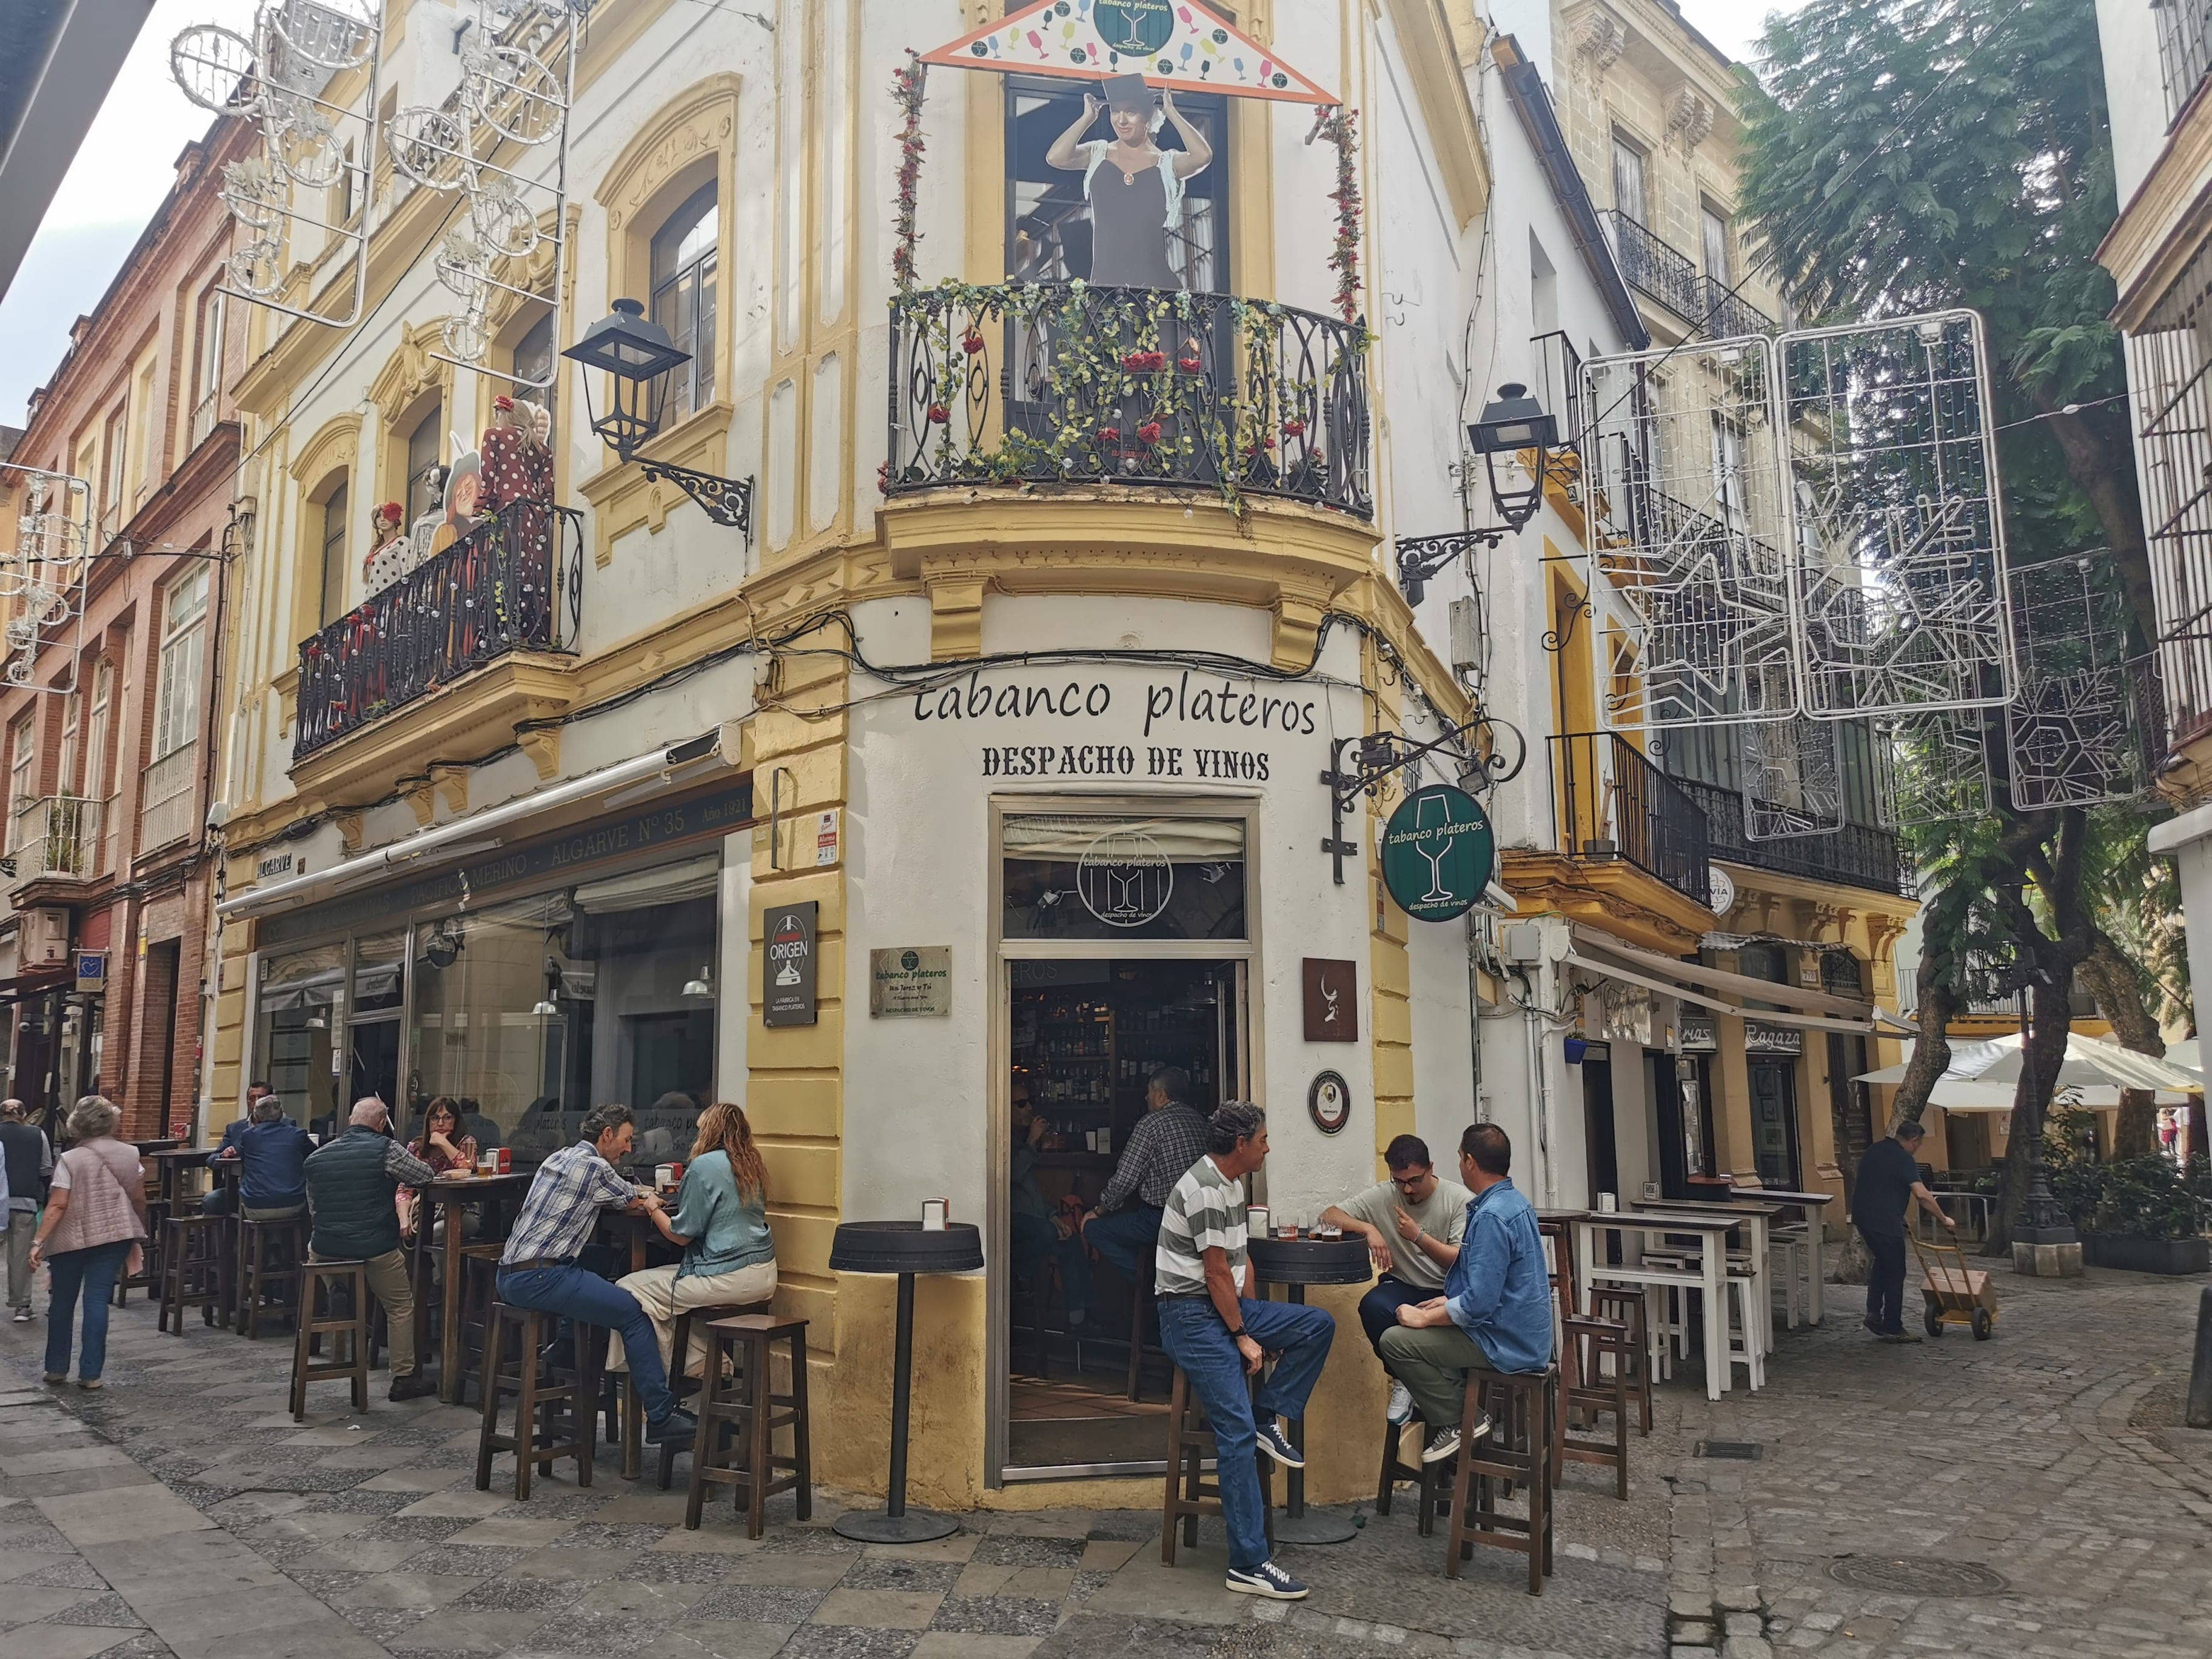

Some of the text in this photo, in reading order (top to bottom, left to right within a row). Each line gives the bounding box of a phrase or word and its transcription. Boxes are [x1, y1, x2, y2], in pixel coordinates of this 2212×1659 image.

[1134, 1, 1168, 12] plateros
[914, 671, 1315, 737] tabanco plateros
[982, 746, 1269, 781] DESPACHO DE VINOS
[1389, 820, 1484, 845] tabanco plateros
[472, 855, 527, 888] MERINO
[551, 826, 629, 866] ALGARVE
[665, 809, 685, 835] 35
[702, 806, 721, 823] Año
[723, 797, 746, 817] 1921
[1084, 856, 1166, 870] tabanco plateros
[1101, 911, 1128, 919] despacho
[1409, 902, 1438, 911] despacho
[769, 940, 808, 960] ORIGEN
[875, 968, 947, 981] tabanco plateros
[1678, 1022, 1711, 1041] rias
[1744, 1024, 1800, 1050] Ragaza
